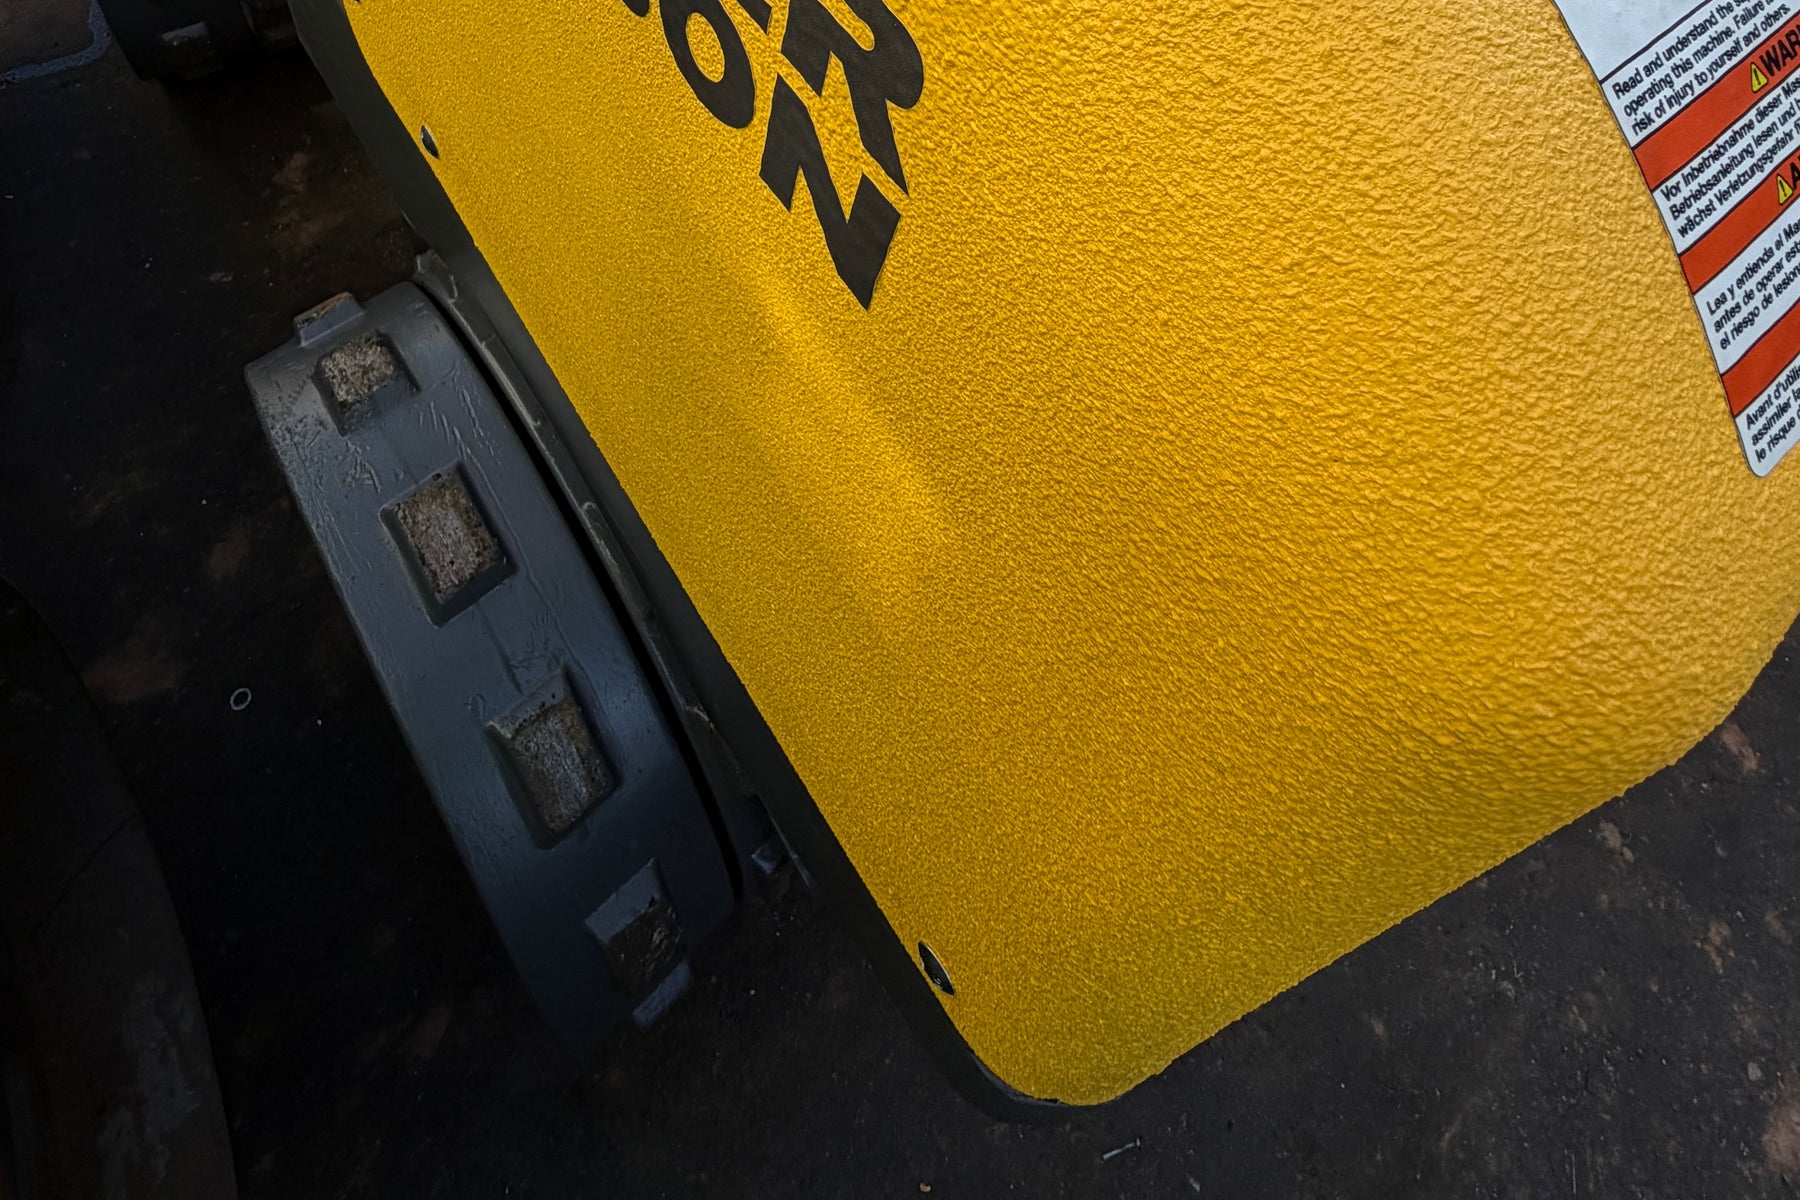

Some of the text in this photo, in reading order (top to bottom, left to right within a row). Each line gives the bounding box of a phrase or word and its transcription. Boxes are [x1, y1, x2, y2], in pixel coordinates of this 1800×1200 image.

[1612, 63, 1643, 99] Read
[1643, 51, 1664, 75] and
[1662, 12, 1719, 63] understand
[1716, 1, 1734, 23] the
[1623, 71, 1674, 117] operating
[1671, 54, 1694, 80] this
[1693, 25, 1736, 65] machine.
[1733, 0, 1765, 30] Failure
[1631, 3, 1791, 136] risk of injury to yourself and others.
[1660, 180, 1682, 202] Vor
[1681, 118, 1756, 186] Inbetriebnahme
[1755, 93, 1783, 124] dieser
[1781, 75, 1800, 100] Mas
[1669, 142, 1756, 220] Betriebsanleitung
[1751, 121, 1779, 149] lesen
[1778, 102, 1796, 127] und
[1677, 201, 1718, 238] wächst
[1714, 129, 1795, 206] Verletzungsgefahr
[1706, 218, 1800, 316] Lea y entienda el Ma
[1713, 240, 1800, 334] antes de operar est
[1720, 261, 1800, 351] el riesgo de lesion
[1746, 393, 1774, 430] Avant
[1751, 396, 1792, 446] assimiler
[1755, 416, 1796, 463] le risque
